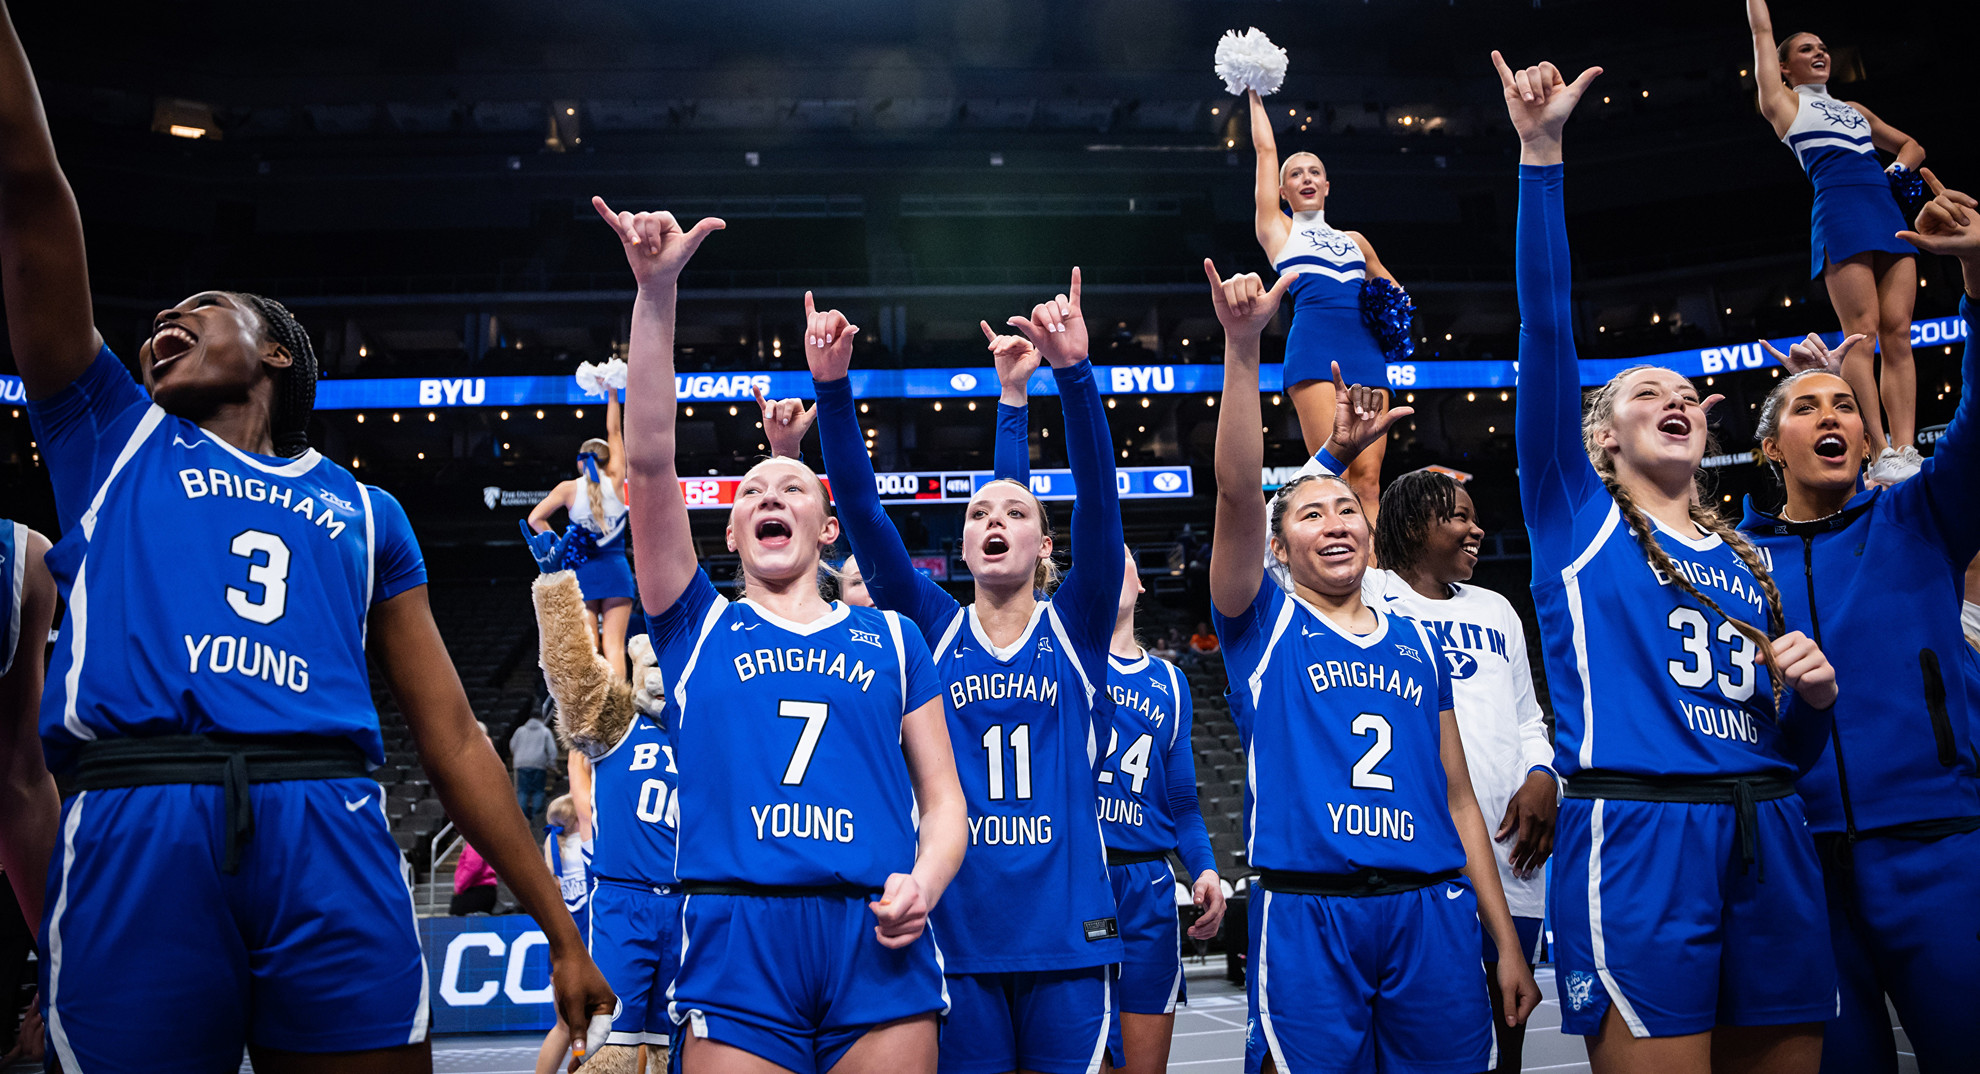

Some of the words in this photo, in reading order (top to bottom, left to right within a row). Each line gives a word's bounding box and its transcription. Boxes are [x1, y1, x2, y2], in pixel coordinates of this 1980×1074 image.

[1110, 366, 1175, 393] BYU
[1700, 343, 1764, 373] BYU
[419, 379, 486, 405] BYU
[178, 468, 347, 540] BRIGHAM
[685, 480, 719, 504] 52
[946, 480, 970, 492] 4TH
[225, 528, 292, 626] 3
[1459, 622, 1482, 650] IT
[1667, 605, 1757, 702] 33
[184, 634, 309, 693] YOUNG
[733, 648, 876, 693] BRIGHAM
[1306, 660, 1423, 707] BRIGHAM
[949, 672, 1058, 710] BRIGHAM
[777, 698, 830, 787] 7
[1679, 699, 1758, 745] YOUNG
[982, 723, 1032, 801] 11
[1350, 712, 1395, 792] 2
[750, 802, 855, 843] YOUNG
[967, 814, 1052, 846] YOUNG
[1327, 802, 1415, 842] YOUNG
